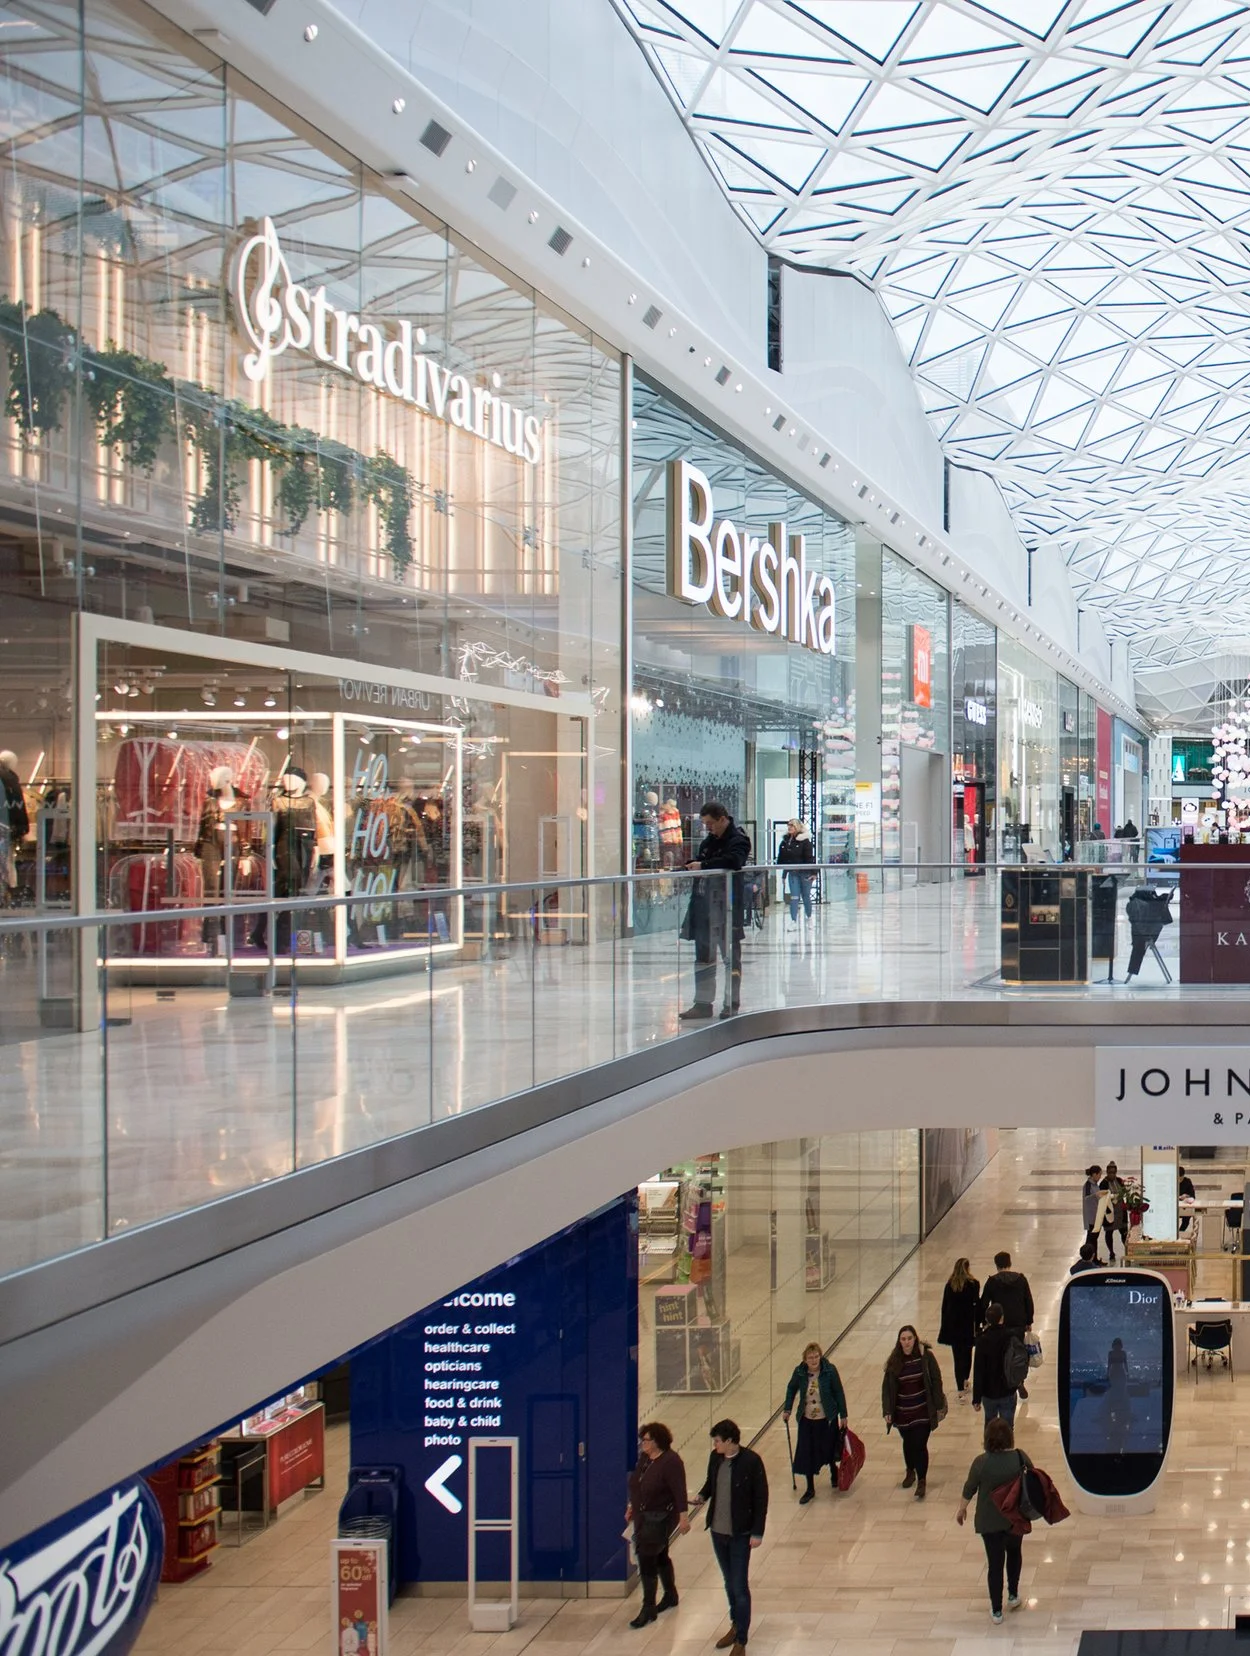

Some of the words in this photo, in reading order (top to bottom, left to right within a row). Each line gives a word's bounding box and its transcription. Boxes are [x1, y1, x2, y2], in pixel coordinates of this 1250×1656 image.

[284, 282, 542, 464] stradivarius
[676, 459, 836, 656] Bershka
[967, 700, 987, 726] GUESS
[351, 749, 390, 800] HO,
[351, 808, 389, 860] HO,
[351, 868, 397, 921] HO!
[1213, 1112, 1224, 1125] &
[1128, 1290, 1158, 1304] Dior
[658, 1302, 679, 1312] hint
[663, 1311, 684, 1322] hint
[424, 1323, 460, 1335] order
[462, 1323, 472, 1335] &
[474, 1323, 516, 1335] collect
[424, 1341, 491, 1353] healthcare
[424, 1360, 483, 1373] opticians
[424, 1379, 499, 1392] hearingcare
[424, 1397, 454, 1408] food
[456, 1397, 467, 1408] &
[469, 1397, 502, 1408] drink
[424, 1416, 456, 1429] baby
[457, 1416, 468, 1427] &
[470, 1416, 501, 1427] child
[424, 1434, 462, 1447] photo
